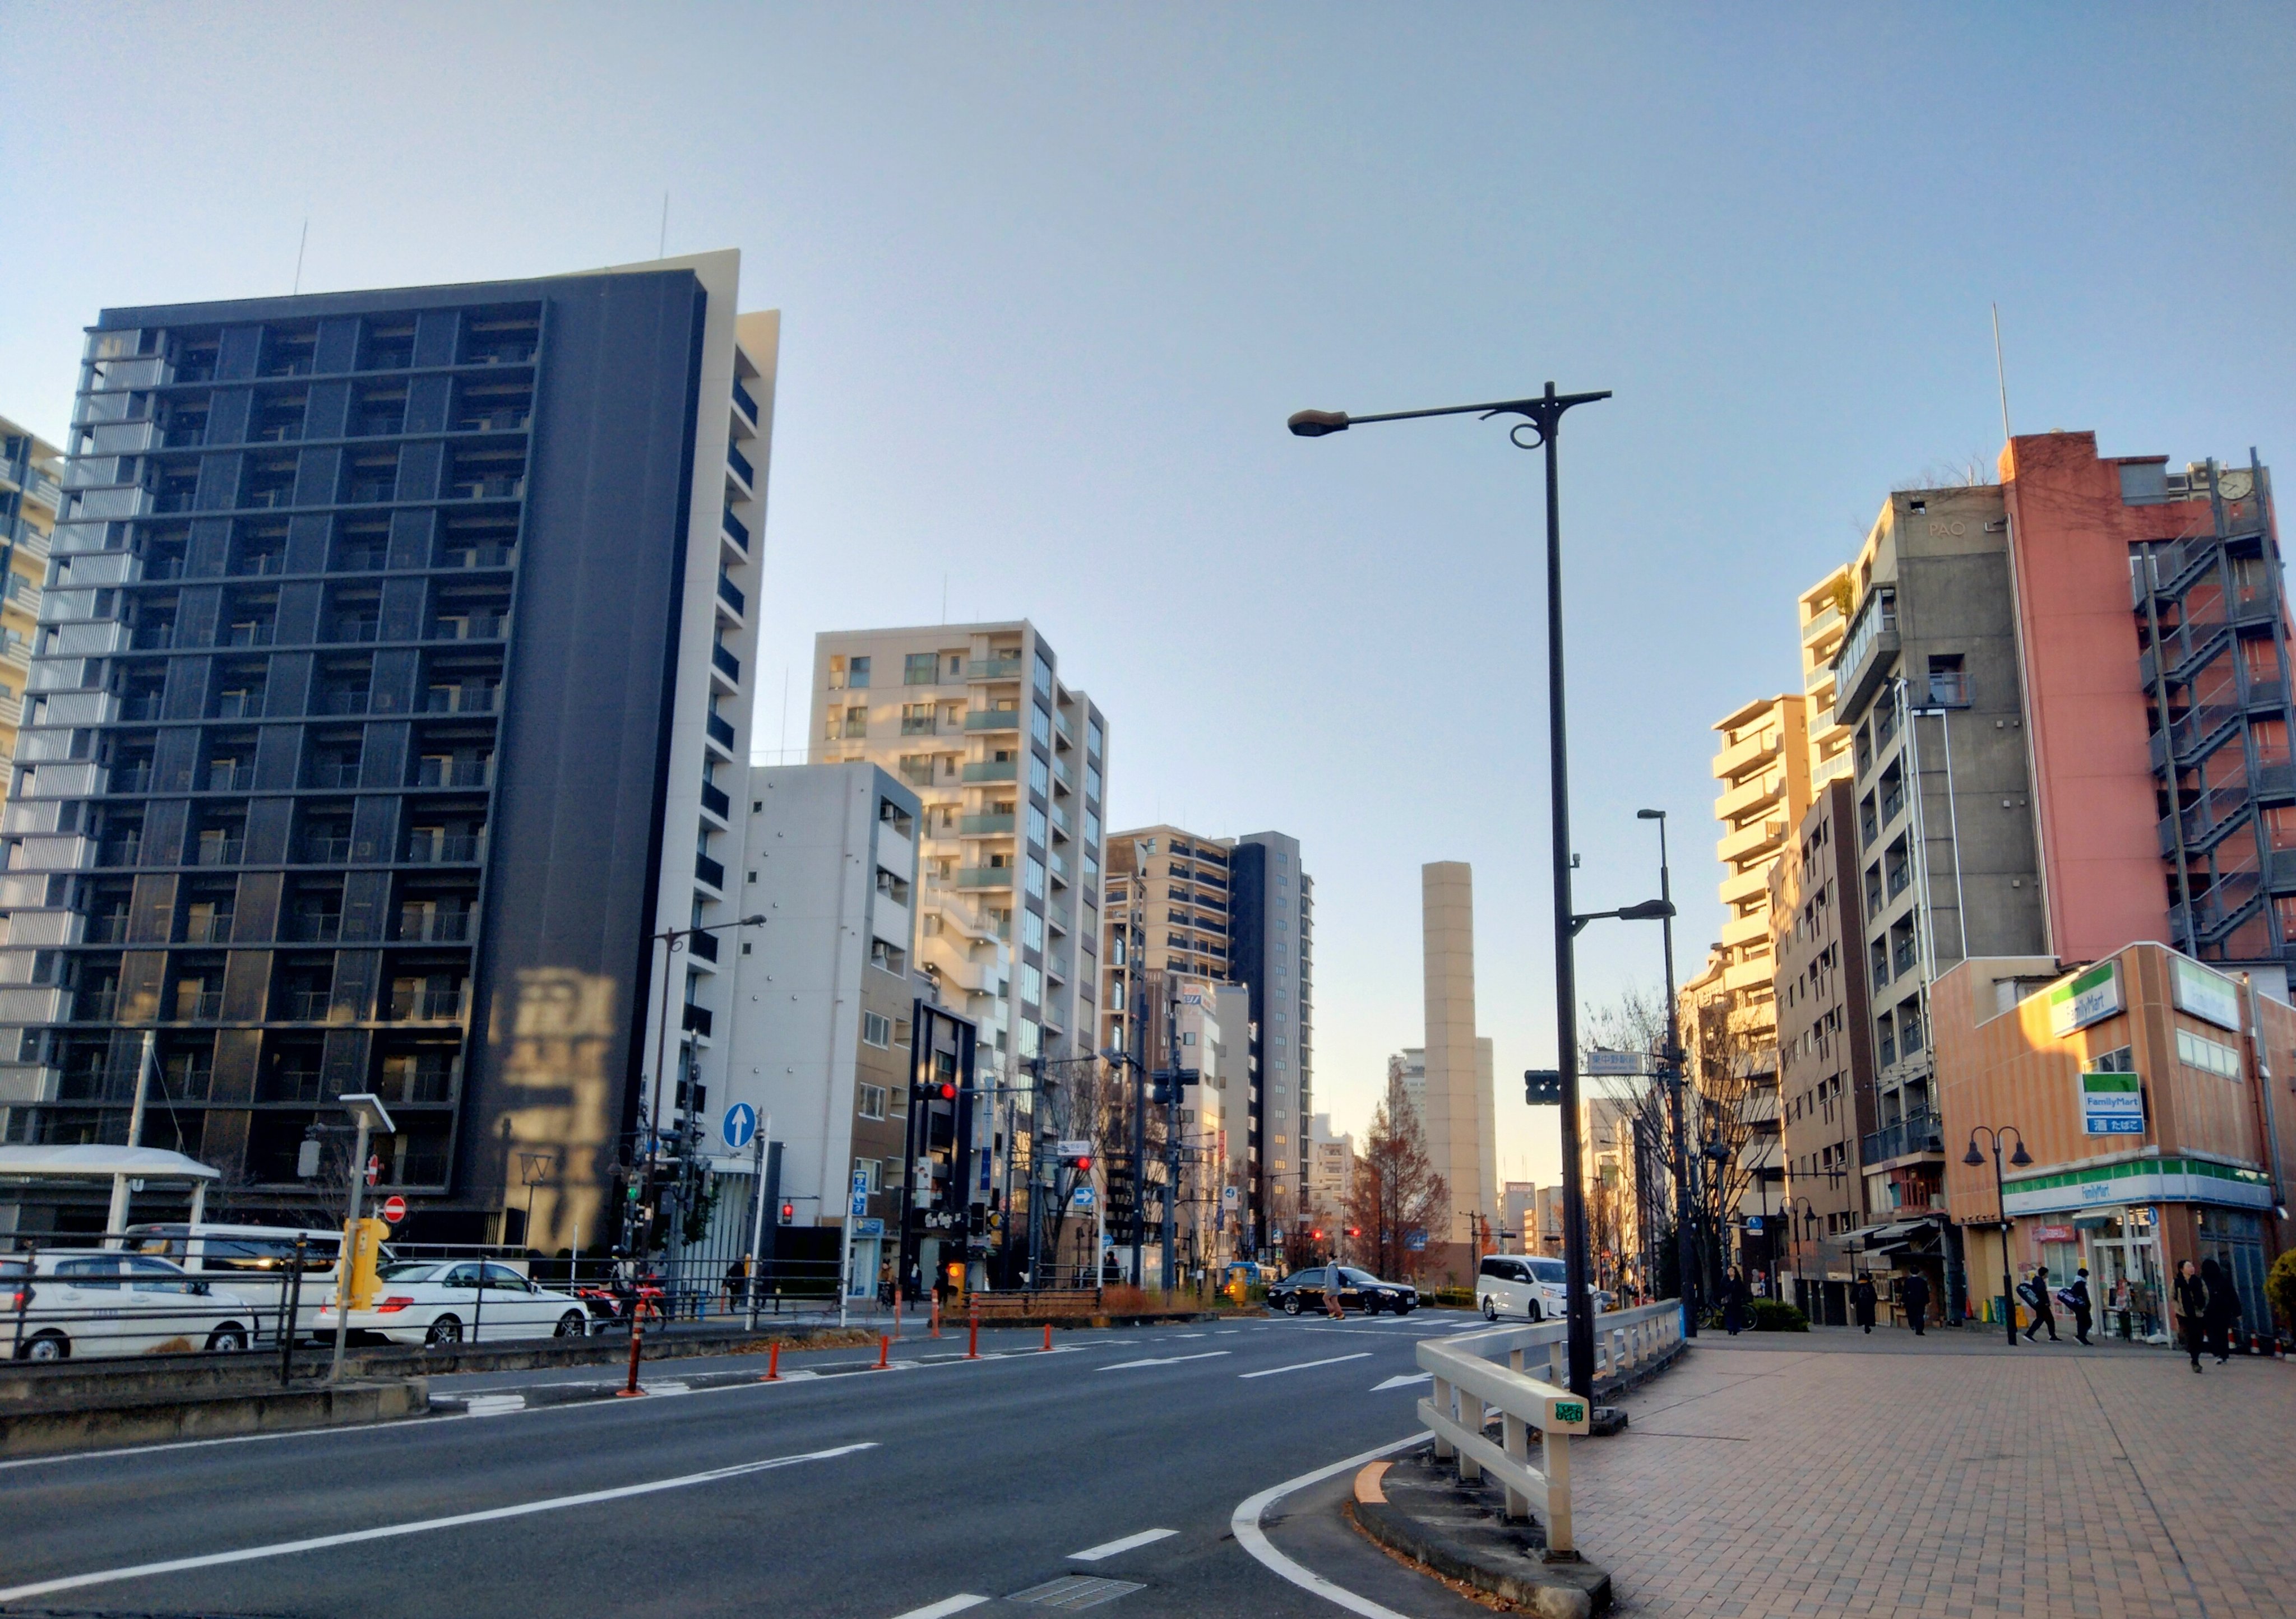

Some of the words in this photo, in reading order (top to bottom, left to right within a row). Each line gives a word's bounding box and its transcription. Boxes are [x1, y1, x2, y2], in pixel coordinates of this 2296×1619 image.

[1929, 522, 1965, 536] PAO
[2066, 992, 2104, 1021] FamilyMart
[1593, 1055, 1636, 1063] 東中野駅前
[2087, 1097, 2138, 1107] FamilyMart
[2094, 1119, 2107, 1131] 酒
[2111, 1120, 2138, 1130] たばこ
[2082, 1184, 2110, 1203] FamilyMart
